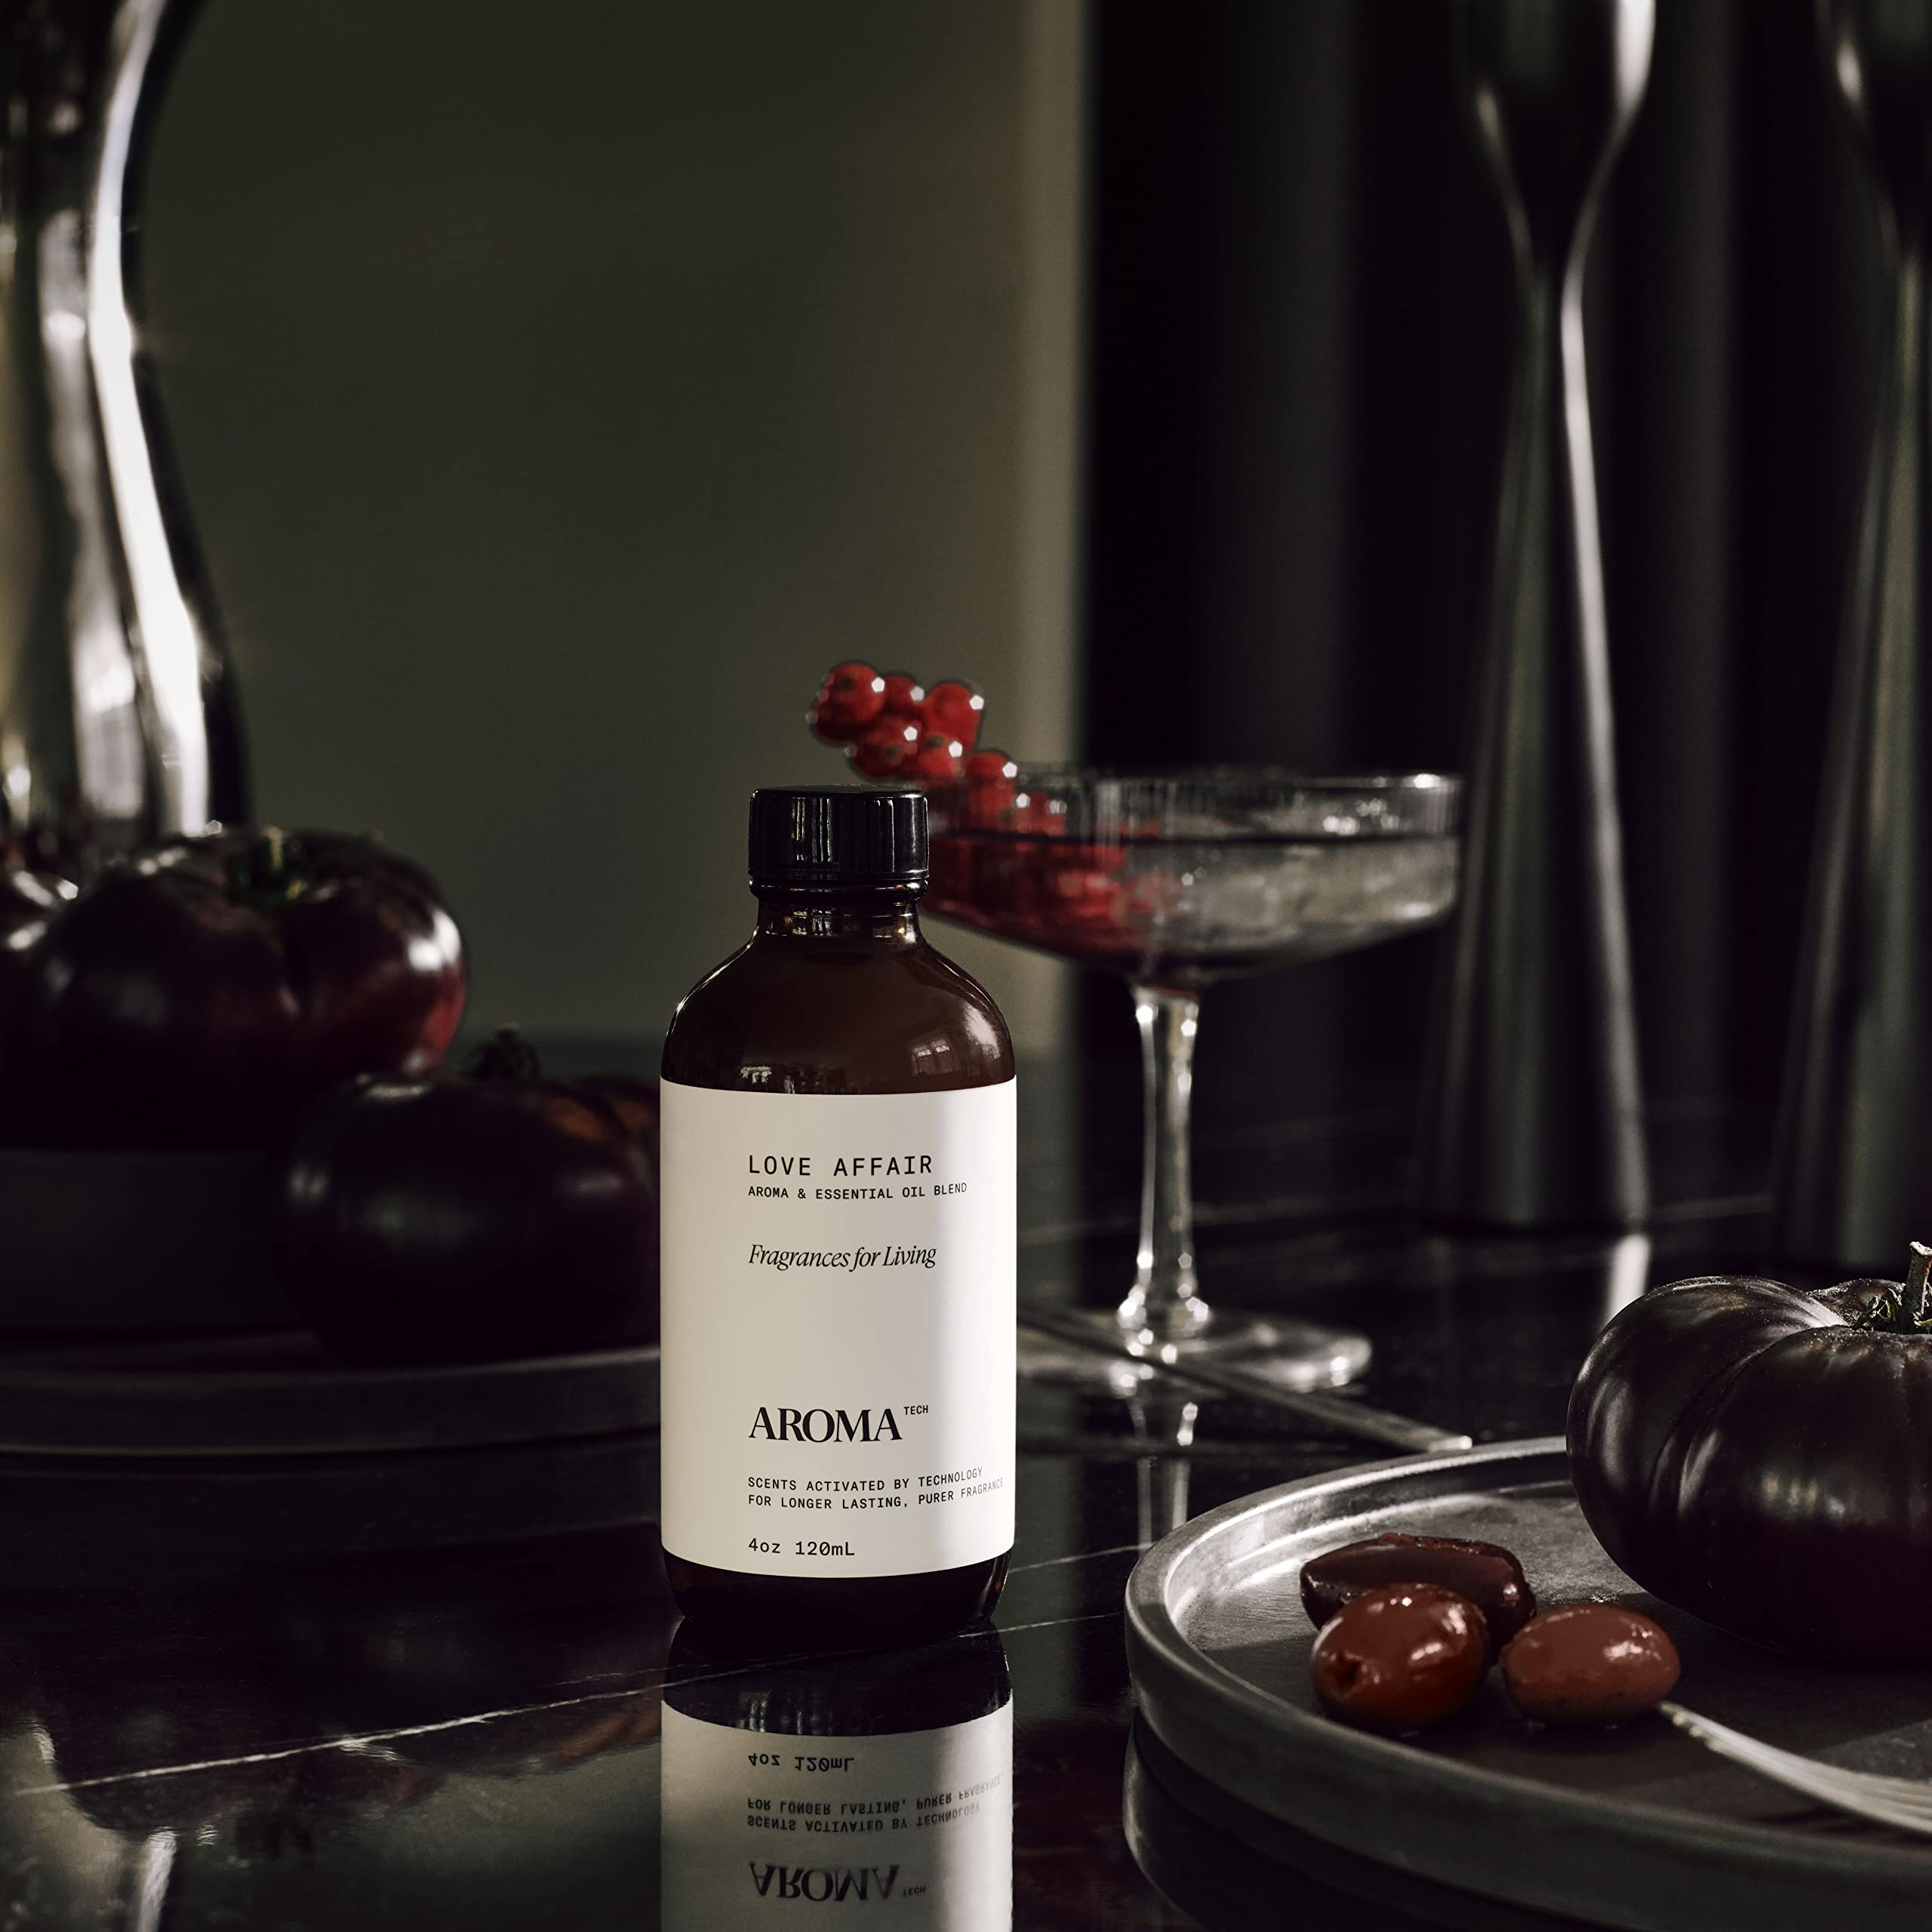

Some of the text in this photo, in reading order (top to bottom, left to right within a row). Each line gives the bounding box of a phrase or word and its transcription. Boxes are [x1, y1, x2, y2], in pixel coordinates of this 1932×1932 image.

[749, 1155, 932, 1177] LOVE AFFAIR
[748, 1183, 968, 1200] AROMA & ESSENTIAL OIL BLEND
[748, 1244, 937, 1272] Fragrances for Living
[749, 1404, 929, 1443] AROMA TECH
[748, 1467, 983, 1492] SCENTS ACTIVATED BY TECHNOLOGY
[748, 1494, 771, 1506] FOR
[781, 1497, 832, 1509] LONGER
[842, 1496, 908, 1509] LASTING,
[918, 1491, 954, 1505] PURER
[749, 1538, 855, 1558] 4oz 120mL
